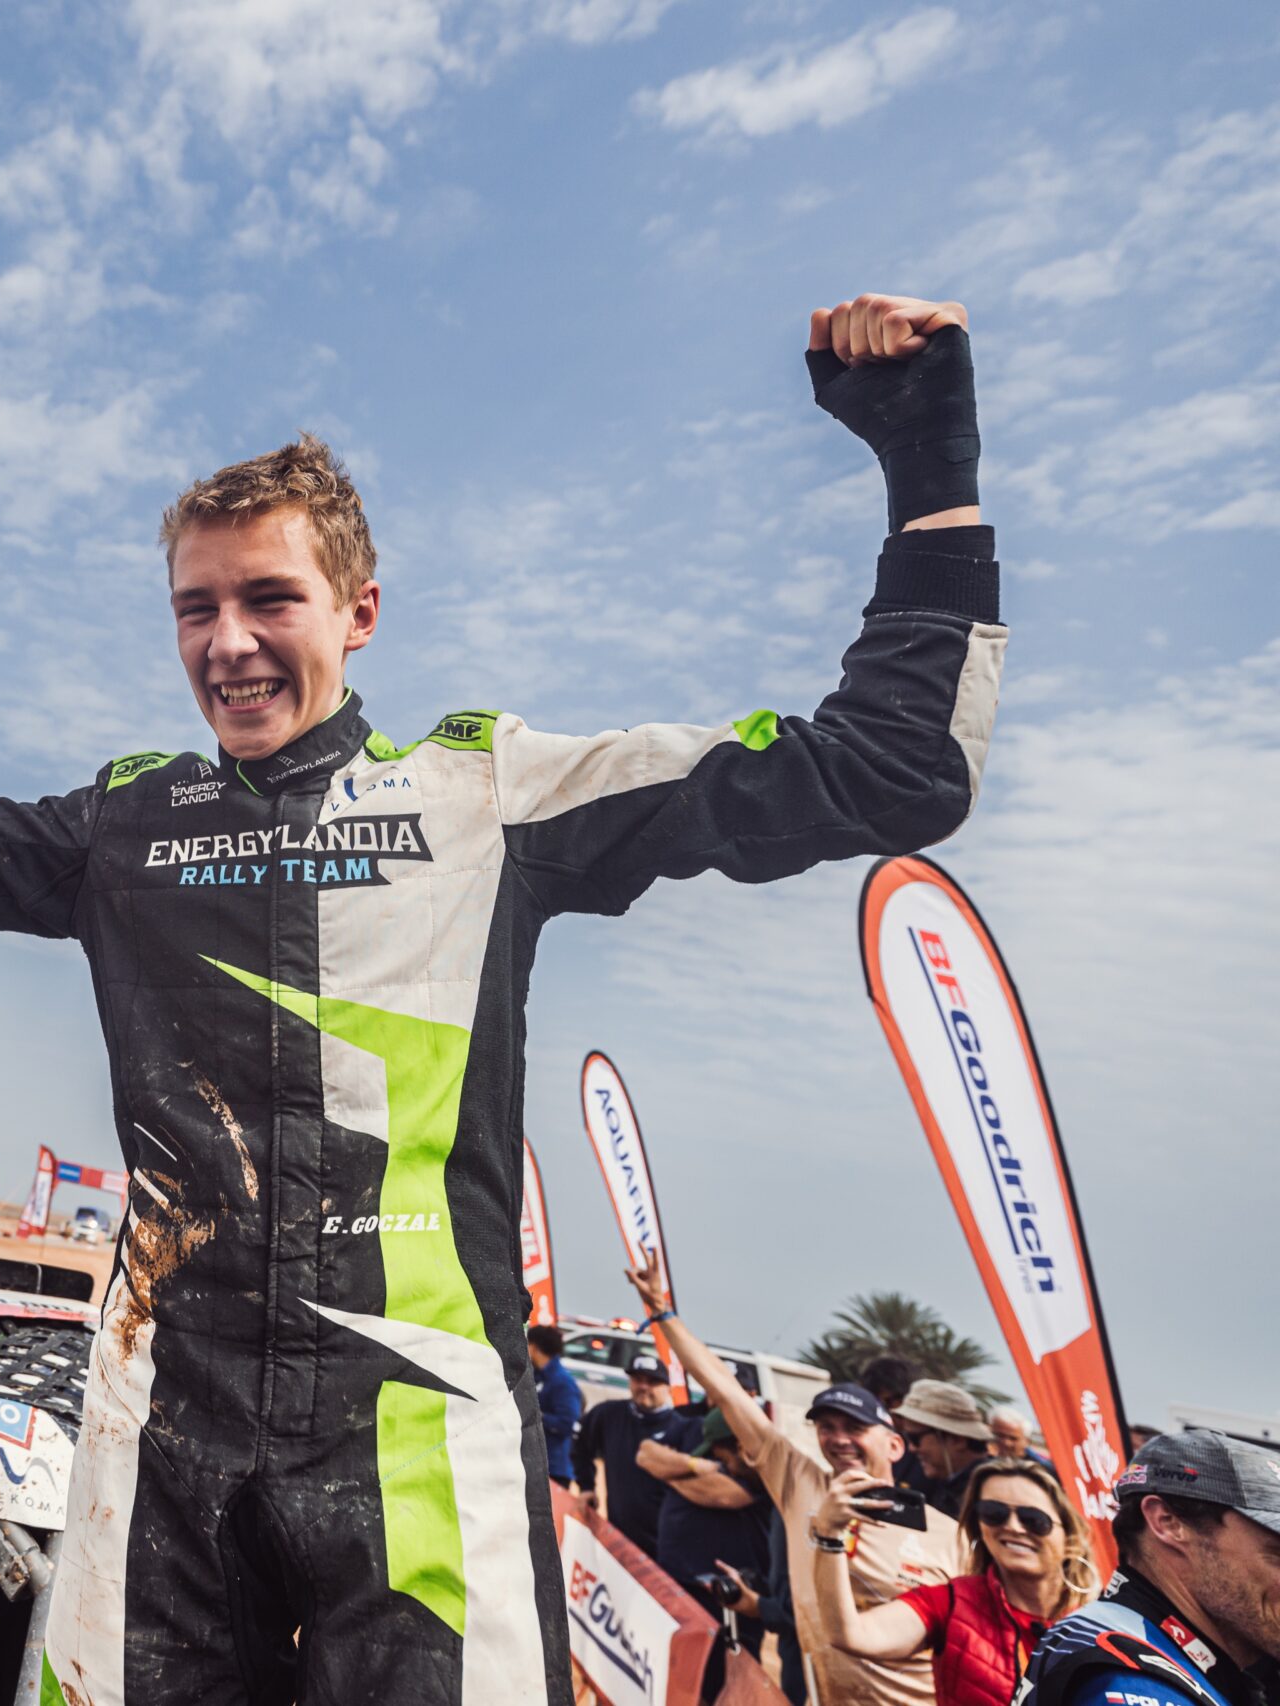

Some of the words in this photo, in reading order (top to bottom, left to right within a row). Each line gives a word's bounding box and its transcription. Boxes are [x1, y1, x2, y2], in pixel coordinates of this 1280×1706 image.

[270, 750, 342, 785] ENERGYLANDIA
[171, 790, 220, 808] LANDIA
[172, 780, 227, 798] ENERGY
[145, 821, 422, 868] ENERGYLANDIA
[179, 865, 268, 886] RALLY
[280, 857, 372, 885] TEAM
[918, 929, 1056, 1293] BFGoodrich
